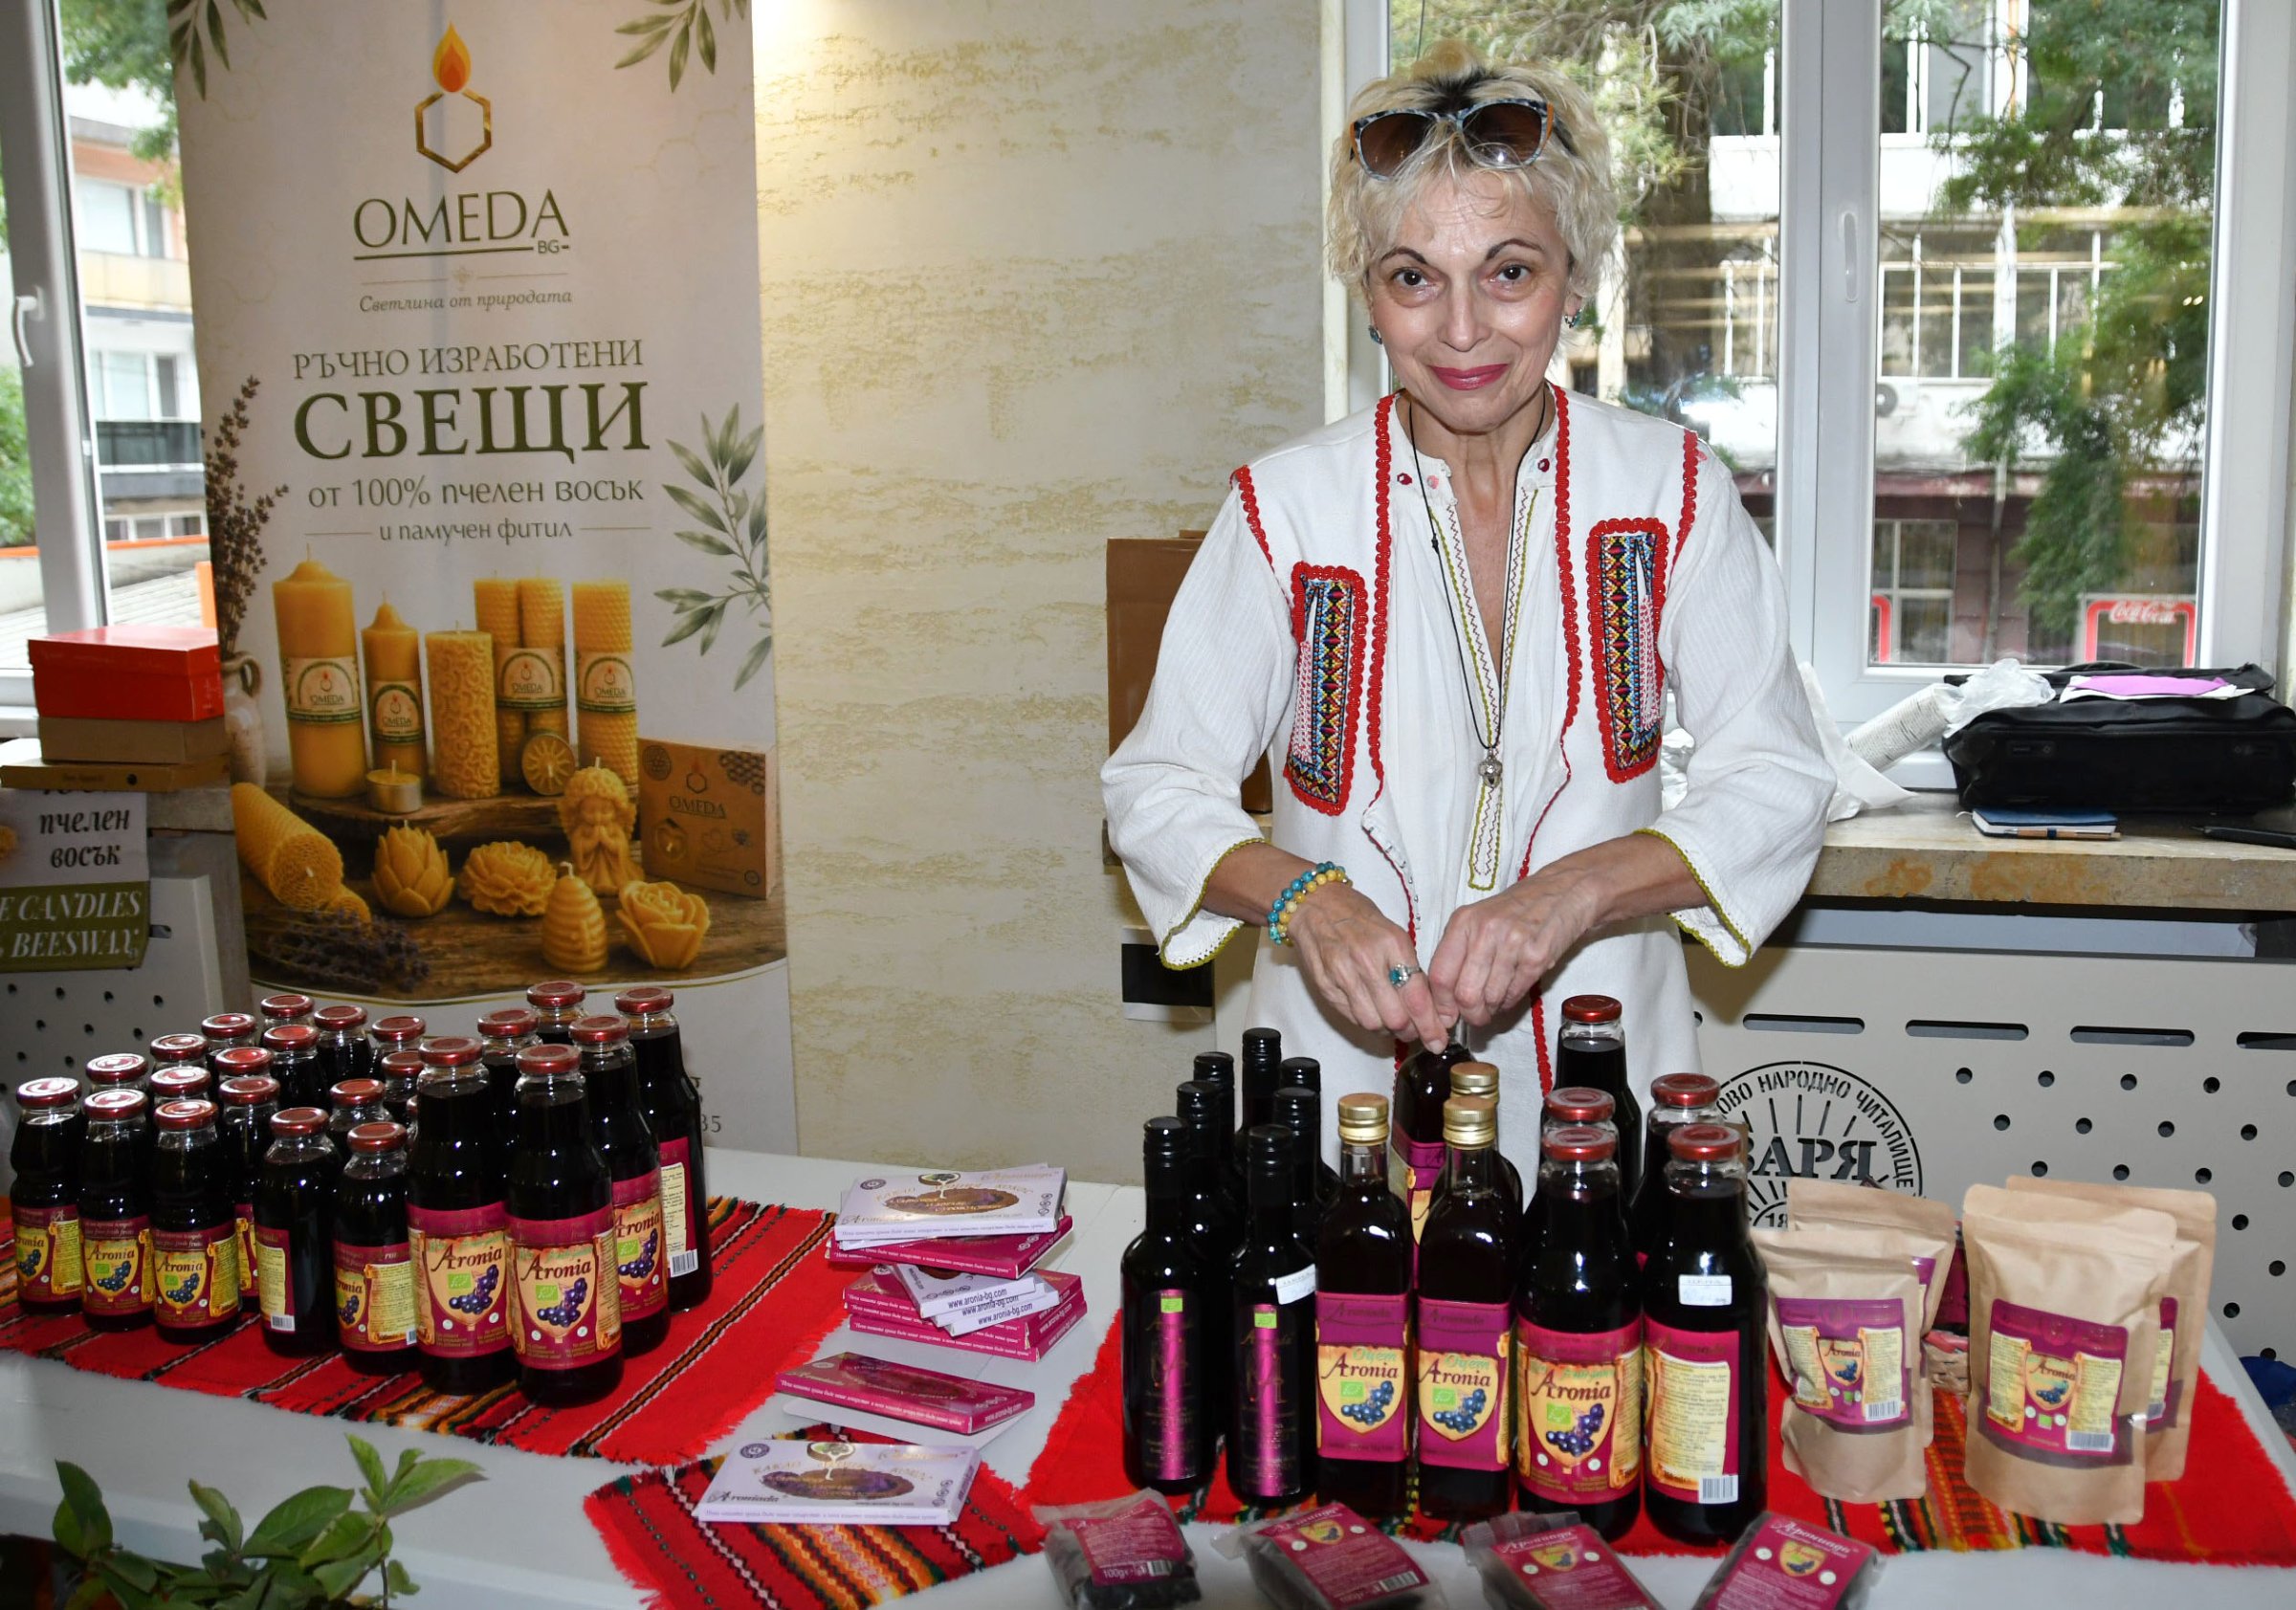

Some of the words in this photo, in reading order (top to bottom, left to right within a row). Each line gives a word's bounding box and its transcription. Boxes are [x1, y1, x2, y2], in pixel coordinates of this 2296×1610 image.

[353, 188, 570, 248] OMEDA
[359, 295, 445, 313] Светлина
[450, 296, 473, 309] от
[476, 289, 573, 312] природата
[292, 348, 409, 380] РЪЧНО
[418, 339, 644, 375] ИЗРАБОТЕНИ
[294, 381, 651, 465] СВЕЩИ
[308, 486, 342, 509] от
[352, 474, 431, 509] 100%
[442, 480, 544, 505] пчелен
[555, 478, 645, 503] восък
[379, 524, 392, 541] и
[399, 521, 492, 547] памучен
[497, 517, 573, 546] фитил
[39, 809, 130, 834] пчелен
[51, 844, 121, 869] восък
[19, 891, 142, 921] CANDLES
[1716, 1082, 1753, 1119] ОВО
[1757, 1070, 1851, 1099] НАРОДНО
[1856, 1090, 1913, 1188] ЧИТАЛИЩЕ
[431, 1243, 503, 1272] Aronia
[520, 1252, 592, 1282] Aronia
[948, 1288, 1007, 1309] www.aronia-bg.com
[978, 1302, 1033, 1325] www.aronia-bg.com
[1320, 1352, 1400, 1379] Aronia
[1418, 1358, 1491, 1387] Aronia
[1531, 1368, 1612, 1400] Aronia
